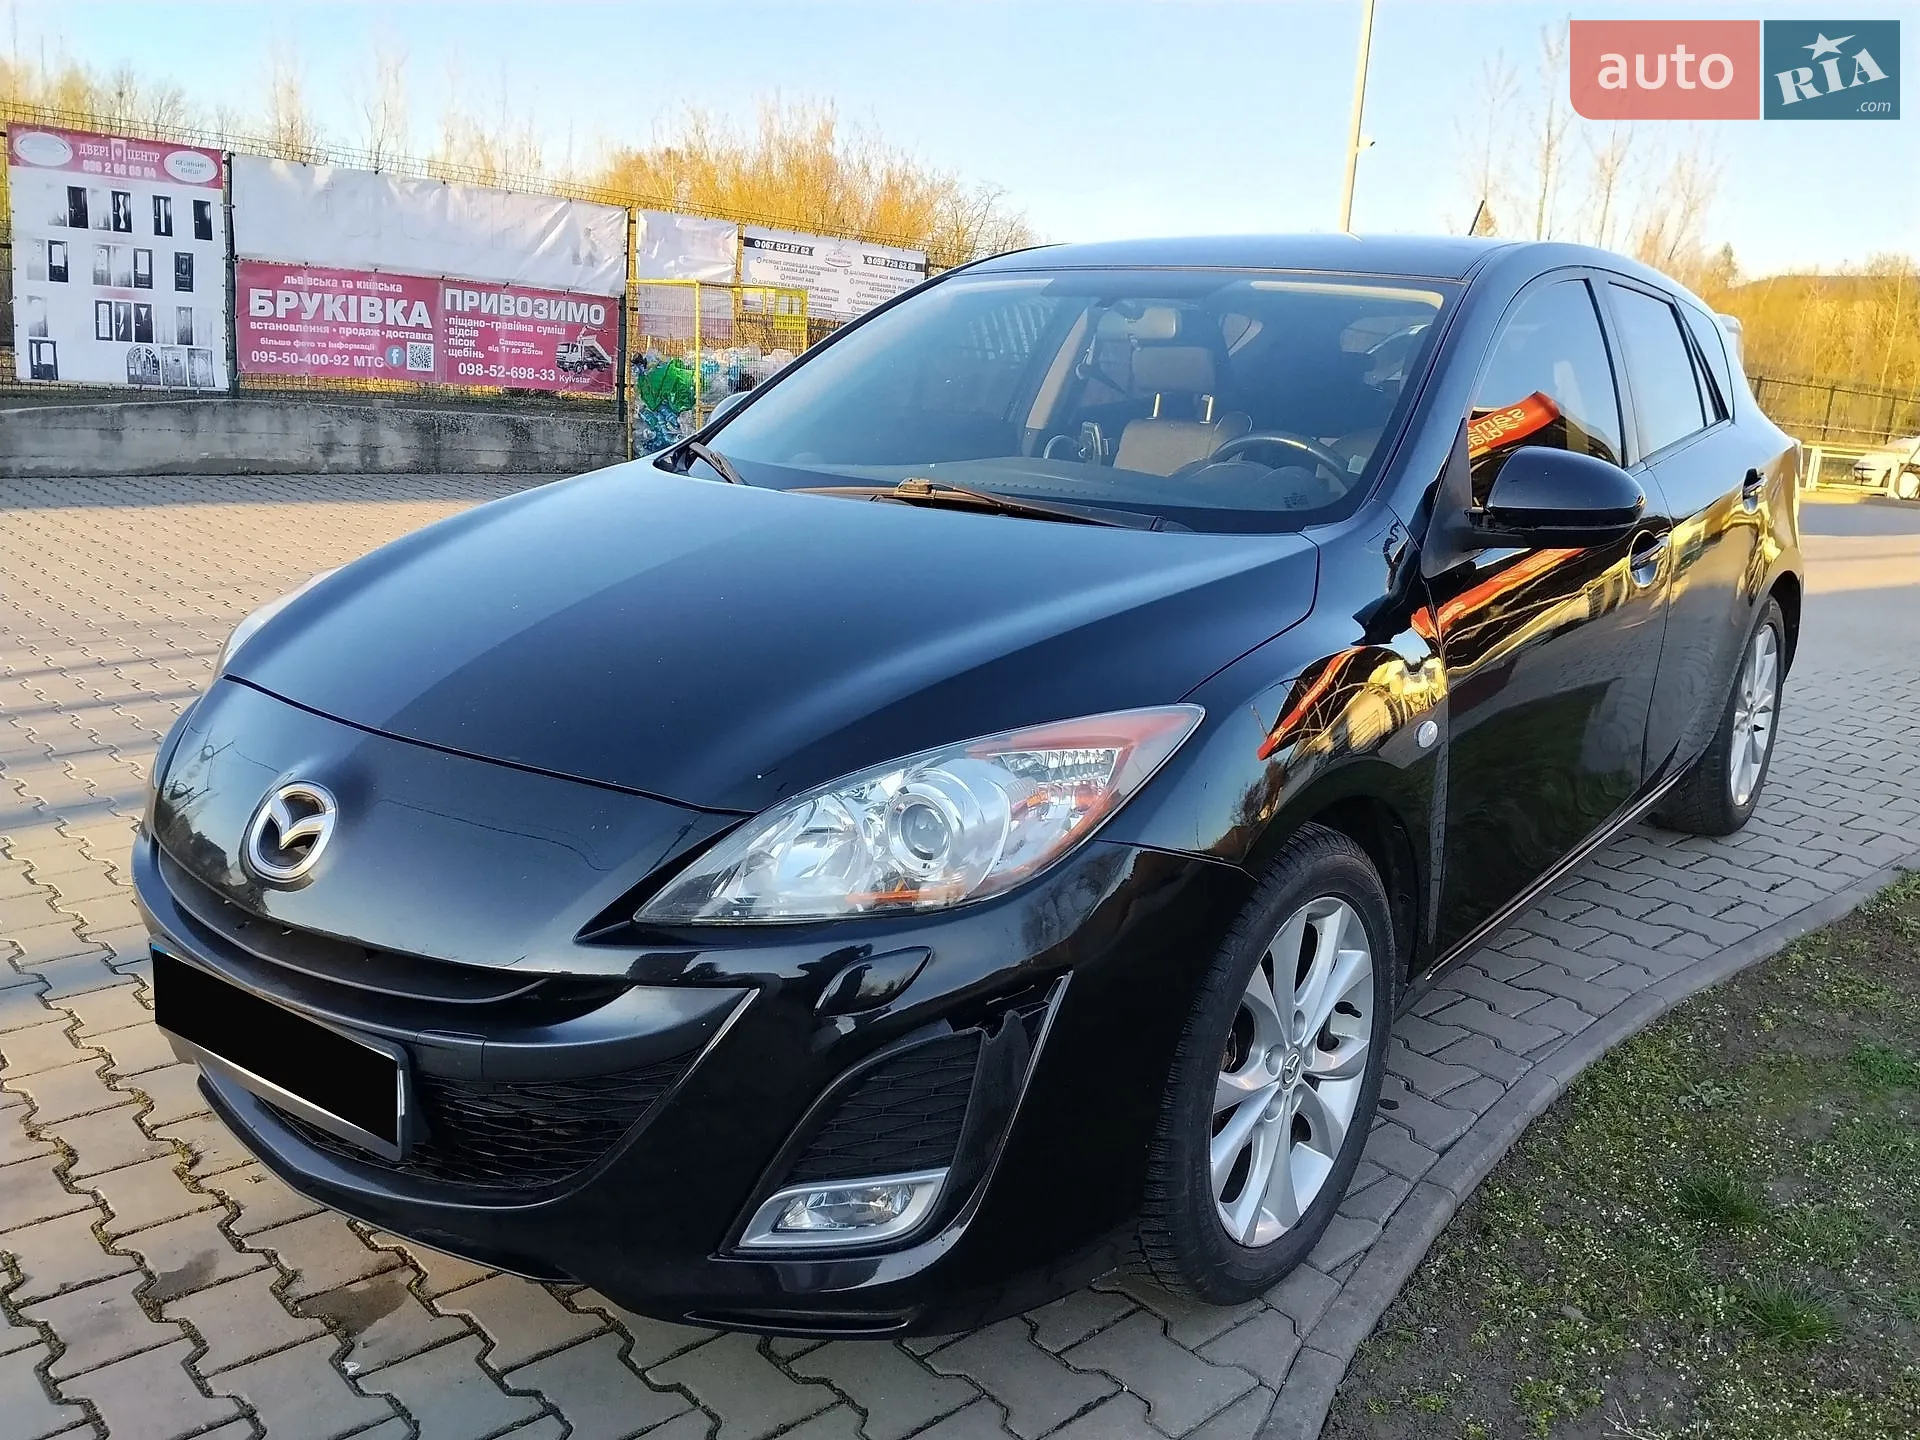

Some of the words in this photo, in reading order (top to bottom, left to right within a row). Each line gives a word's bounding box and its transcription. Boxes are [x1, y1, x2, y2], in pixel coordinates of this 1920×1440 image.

[79, 143, 109, 158] ДВЕРІ
[127, 149, 160, 163] ЦЕНТР
[104, 162, 112, 173] 2
[776, 243, 789, 252] 512
[341, 279, 353, 289] та
[249, 288, 433, 329] БРУКІВКА
[445, 288, 605, 325] ПРИВОЗИМО
[250, 321, 330, 334] встановлення
[338, 326, 381, 337] продаж
[385, 329, 434, 341] доставка
[448, 315, 534, 332] піщано-гравійна
[537, 324, 566, 336] суміш
[448, 326, 479, 337] відсів
[293, 339, 316, 349] фото
[448, 337, 476, 347] пісок
[251, 350, 350, 366] 095-50-400-92
[353, 355, 385, 368] МТС
[448, 347, 485, 359] щебінь
[458, 362, 556, 382] 098-52-698-33
[559, 374, 591, 384] Kyivstar
